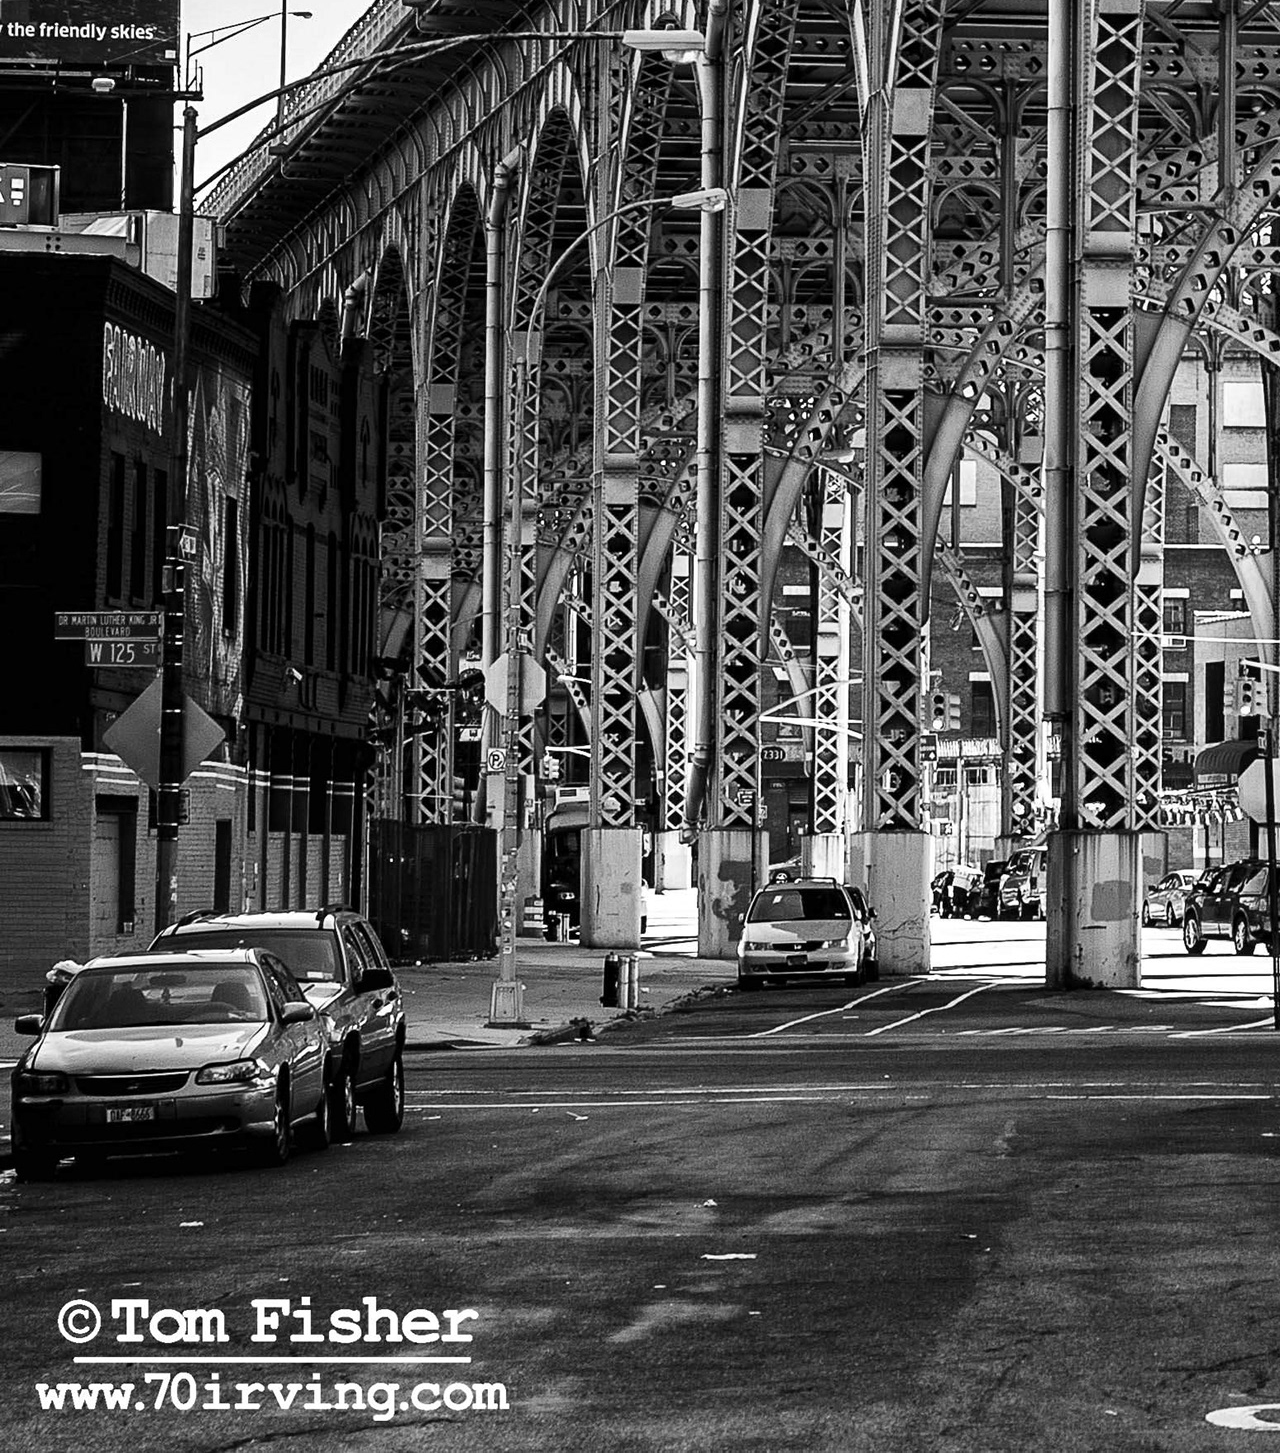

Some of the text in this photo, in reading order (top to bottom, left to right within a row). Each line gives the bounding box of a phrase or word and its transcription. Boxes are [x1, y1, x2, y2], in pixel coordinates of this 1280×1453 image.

[7, 22, 35, 37] the
[39, 22, 107, 41] friendly
[111, 24, 154, 39] skies
[58, 615, 157, 626] DR MARTIN LUTHER KING JR
[85, 627, 130, 637] BOULEVARD
[90, 643, 156, 663] W 125 ST
[763, 750, 783, 760] 2331
